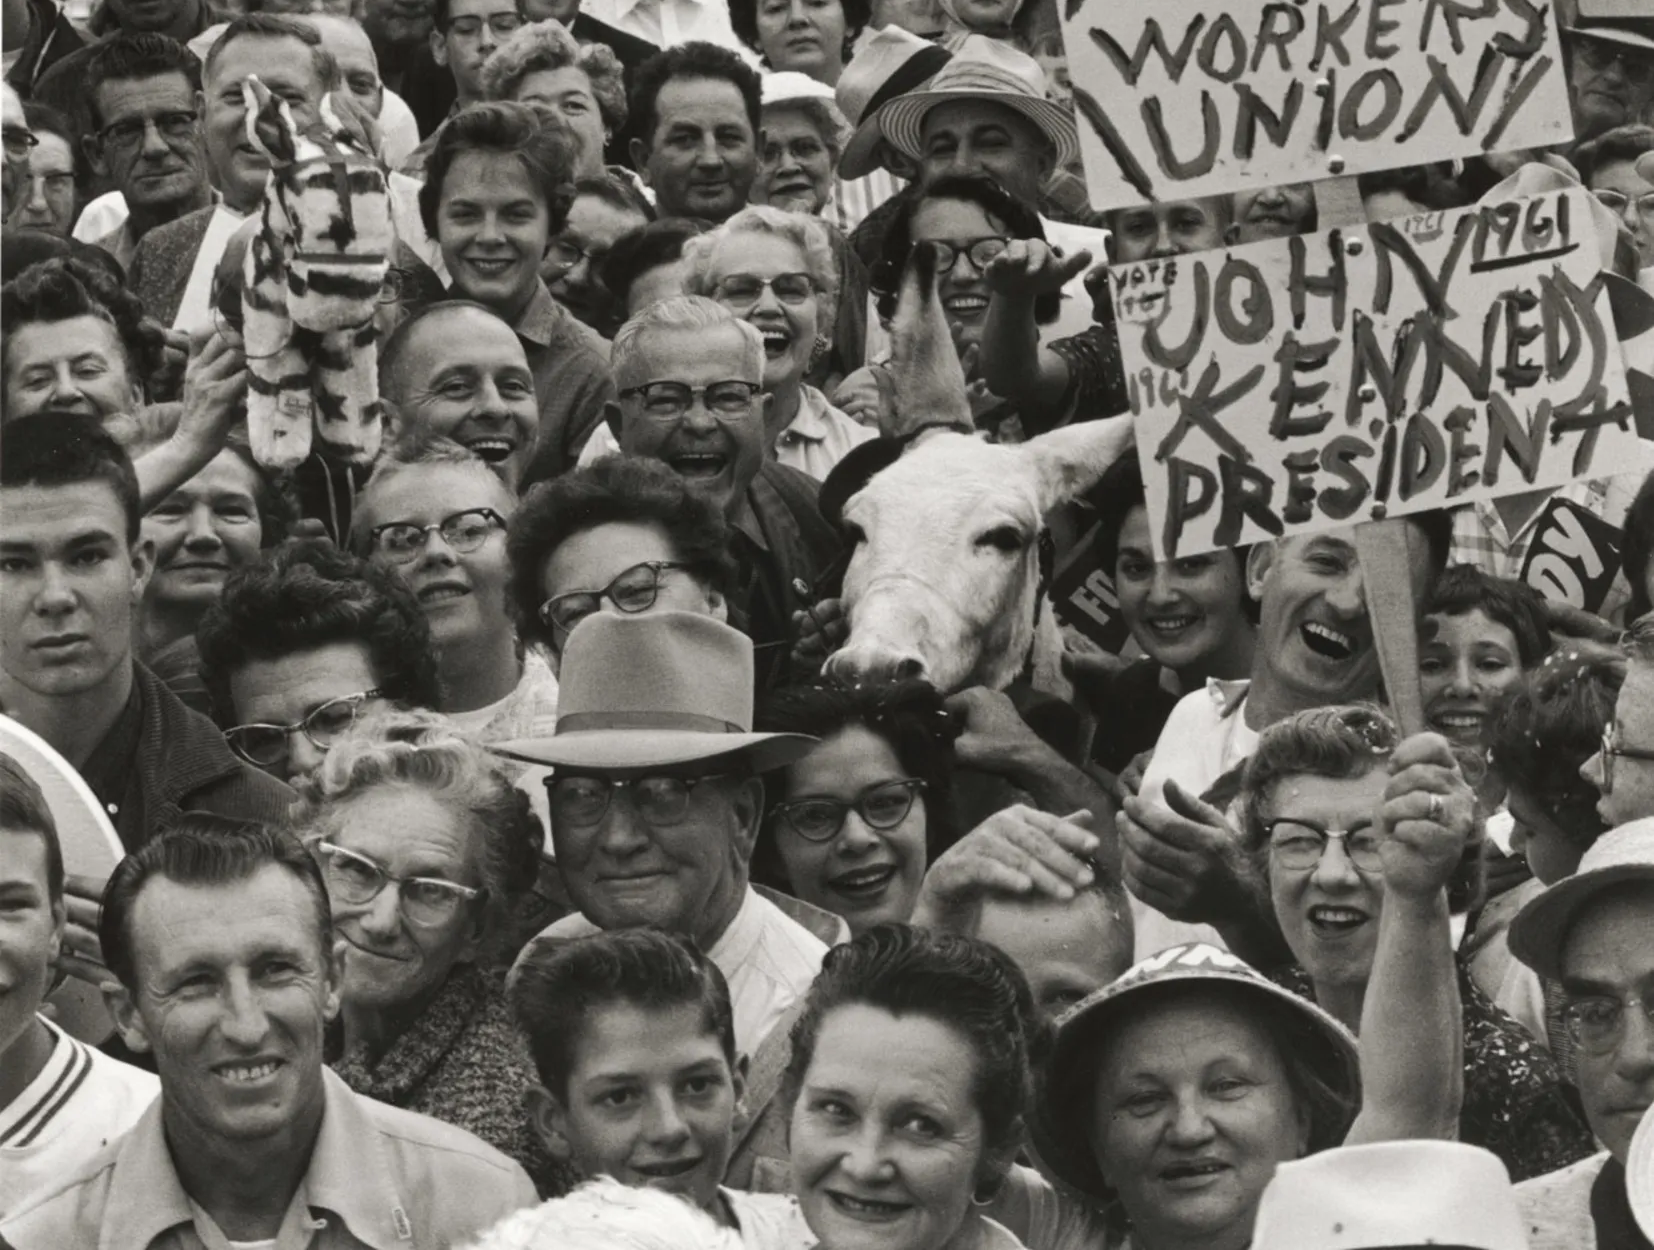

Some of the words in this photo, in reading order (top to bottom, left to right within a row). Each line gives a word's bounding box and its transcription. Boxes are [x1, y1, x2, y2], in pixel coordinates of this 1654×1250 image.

[1140, 42, 1507, 181] UNION
[1108, 261, 1178, 289] VOTE
[1141, 212, 1478, 373] JOHN
[1473, 193, 1570, 263] 1961
[1154, 262, 1609, 464] KENNEDY
[1161, 385, 1632, 562] PRESIDENT
